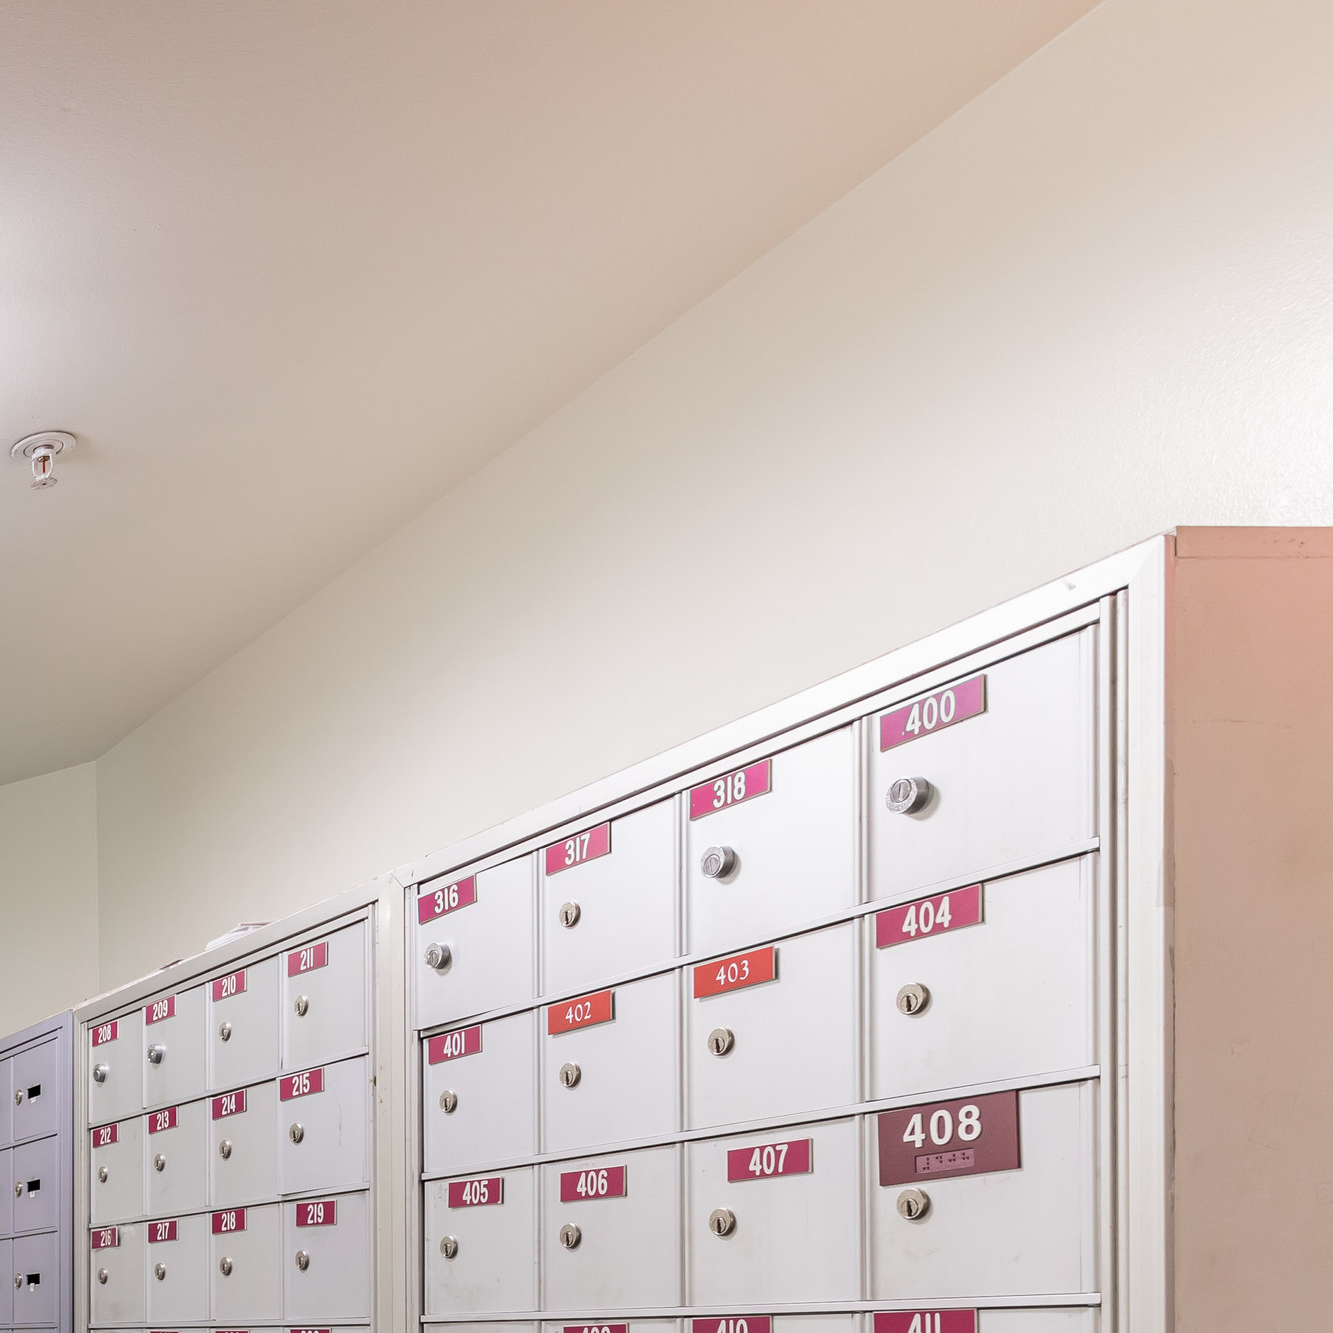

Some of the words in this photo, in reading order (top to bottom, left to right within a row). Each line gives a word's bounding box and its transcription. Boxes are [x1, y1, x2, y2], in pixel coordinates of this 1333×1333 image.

[905, 689, 956, 735] 400
[713, 772, 745, 808] 318
[564, 834, 591, 864] 317
[434, 885, 459, 912] 316
[902, 896, 951, 936] 404
[300, 948, 313, 970] 211
[716, 960, 749, 985] 403
[222, 977, 237, 997] 210
[153, 1001, 168, 1020] 209
[566, 1002, 591, 1023] 402
[98, 1024, 111, 1042] 208
[444, 1032, 464, 1057] 401
[292, 1075, 310, 1095] 215
[222, 1094, 236, 1114] 214
[157, 1111, 169, 1130] 213
[903, 1105, 981, 1147] 408
[100, 1129, 111, 1144] 212
[749, 1144, 788, 1175] 407
[463, 1180, 488, 1204] 405
[577, 1170, 607, 1196] 406
[222, 1212, 235, 1231] 218
[307, 1203, 323, 1224] 219
[157, 1223, 169, 1240] 217
